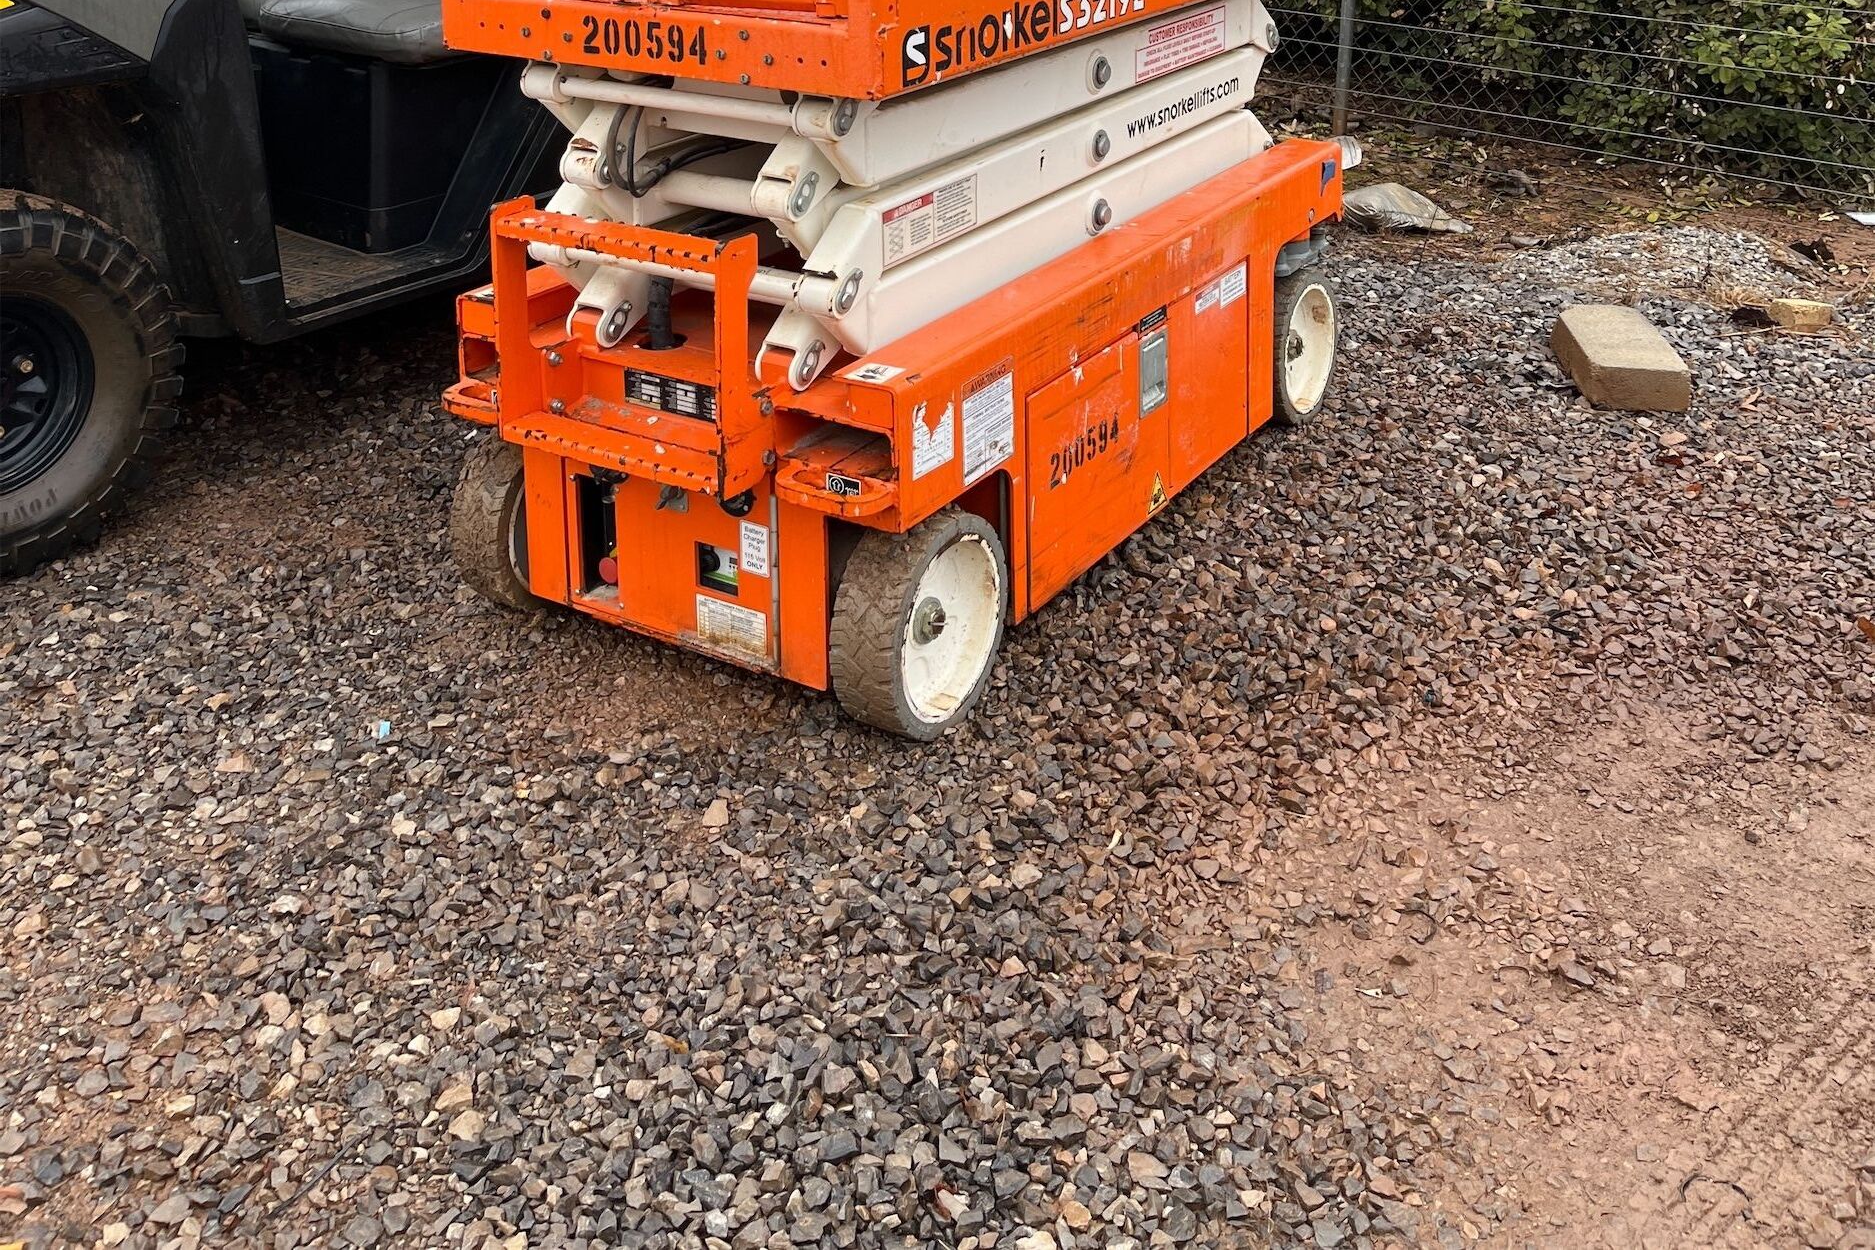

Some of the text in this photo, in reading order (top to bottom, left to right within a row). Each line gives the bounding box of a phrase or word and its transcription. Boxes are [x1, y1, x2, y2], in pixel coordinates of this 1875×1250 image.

[1148, 14, 1214, 44] CUSTOMER RESPONSIBILITY
[582, 15, 707, 66] 200594
[1127, 77, 1239, 138] www.snorkellifts.com
[1050, 412, 1118, 490] 200594
[744, 526, 764, 537] Battery
[744, 534, 765, 544] Charger
[748, 542, 761, 552] Plug
[746, 560, 763, 570] ONLY
